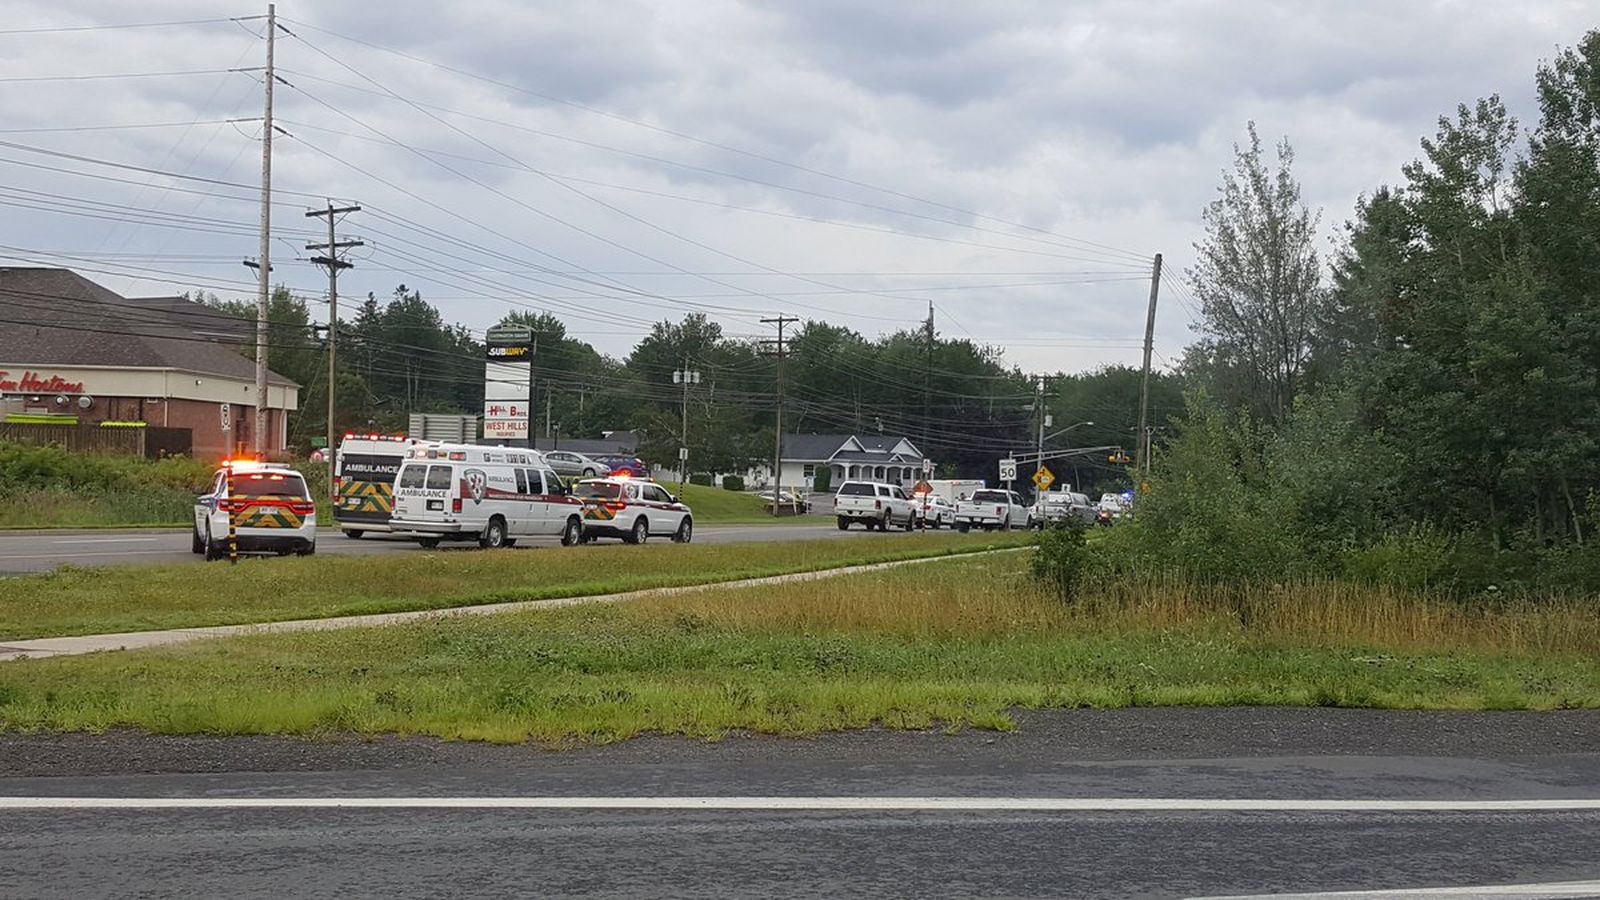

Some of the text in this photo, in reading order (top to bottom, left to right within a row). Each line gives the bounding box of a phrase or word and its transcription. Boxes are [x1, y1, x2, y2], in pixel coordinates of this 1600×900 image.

[488, 347, 528, 356] SUBWAY
[19, 371, 86, 393] Hortons
[486, 422, 528, 430] WEST HILLS
[345, 463, 399, 473] AMBULANCE
[1001, 467, 1015, 478] 50
[400, 489, 447, 498] AMBULANCE
